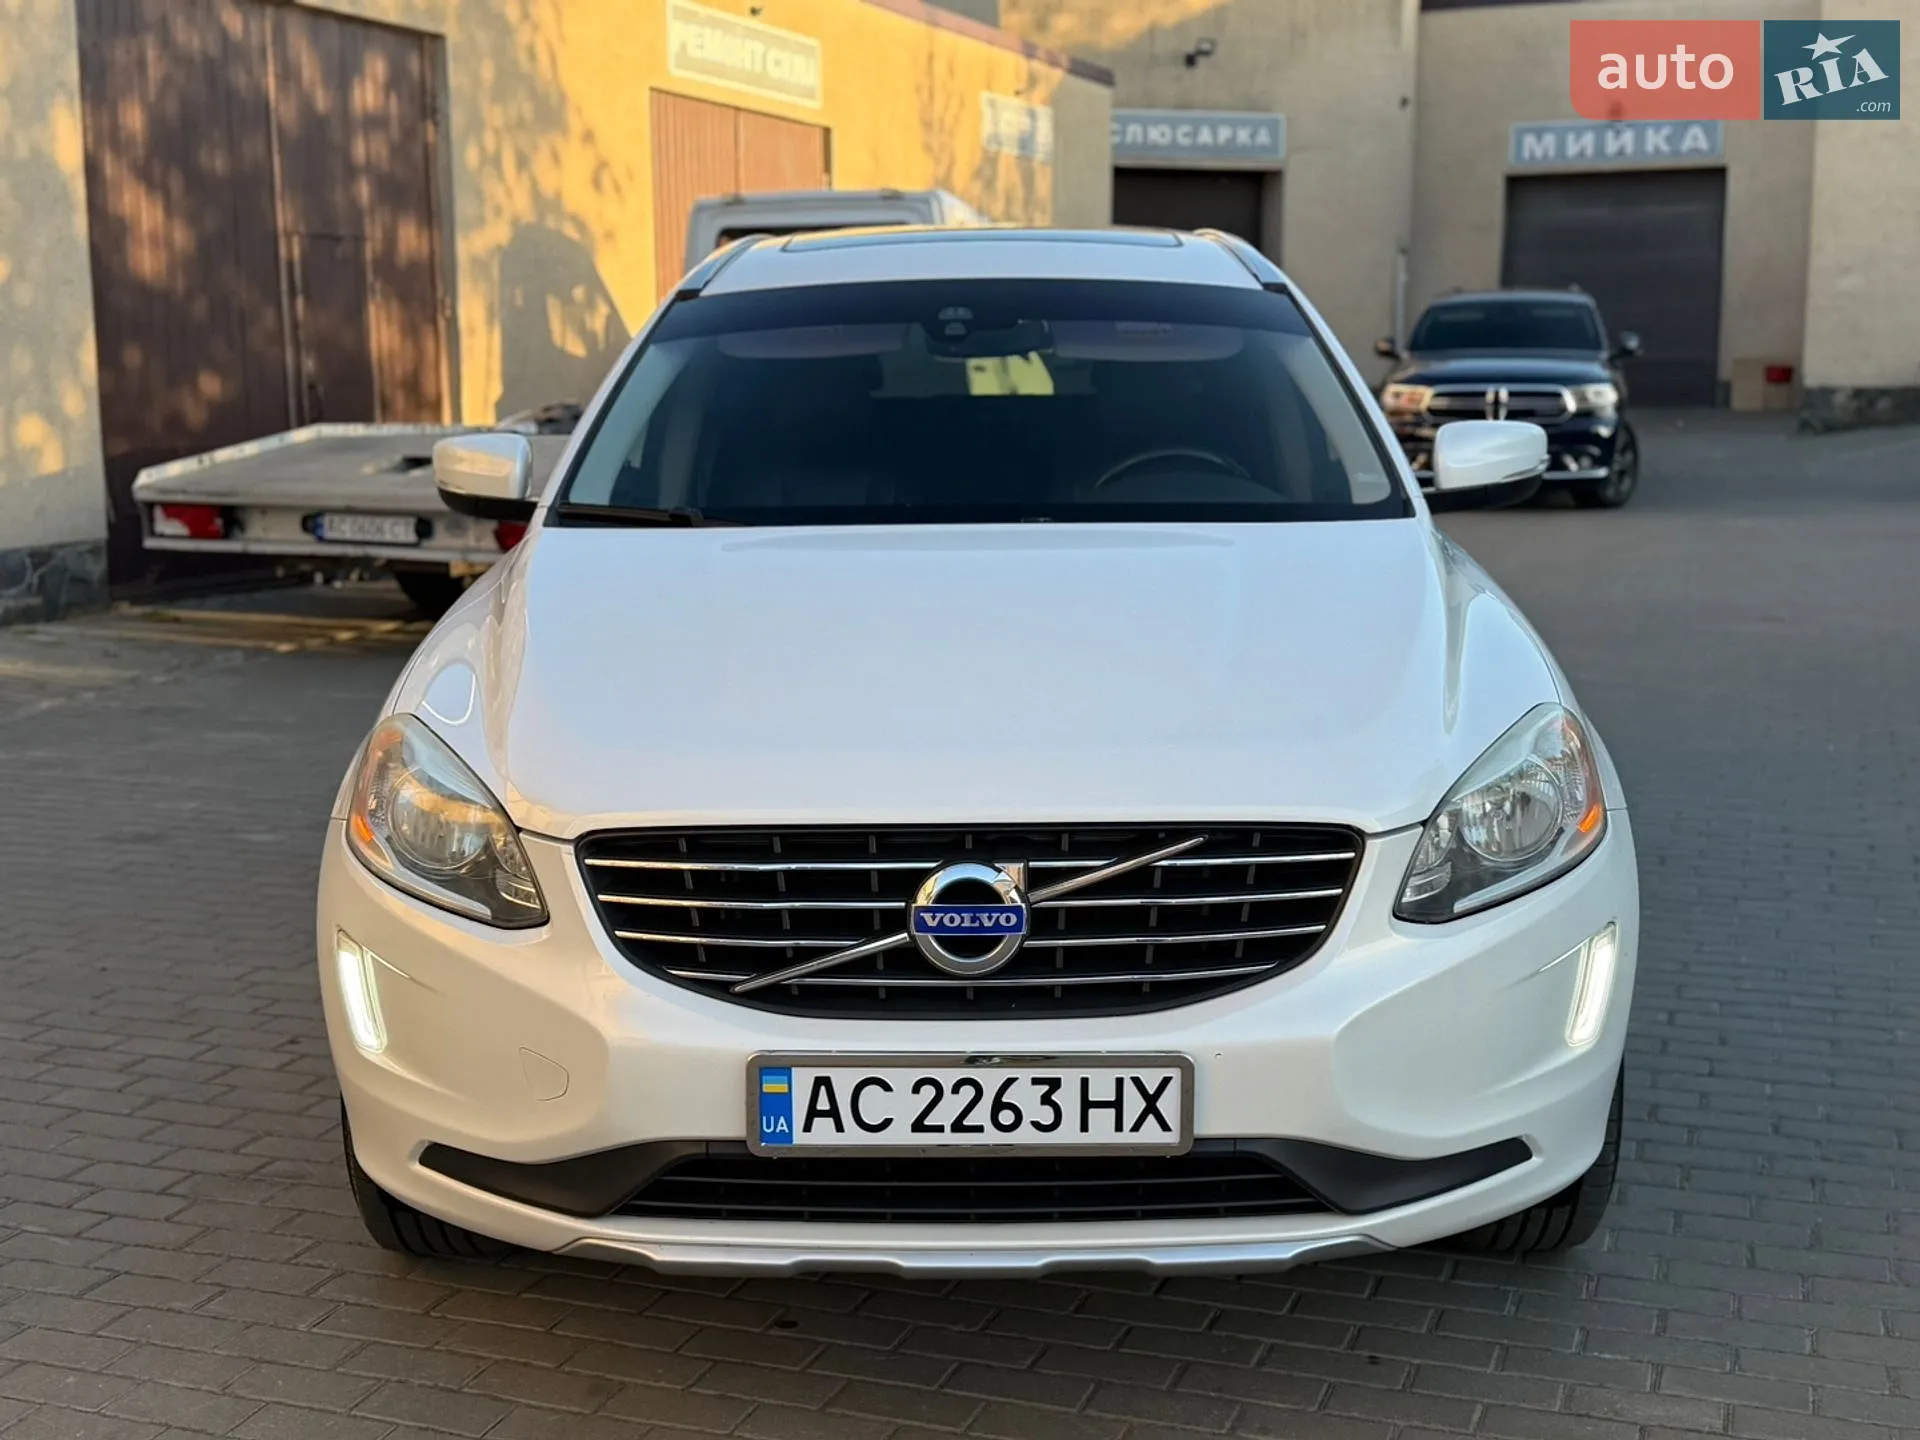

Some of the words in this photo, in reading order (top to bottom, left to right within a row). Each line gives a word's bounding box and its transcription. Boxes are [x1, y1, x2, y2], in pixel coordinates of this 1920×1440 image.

[1522, 122, 1710, 161] МИЙКА
[920, 912, 1018, 928] VOLVO
[802, 1075, 895, 1134] AC
[909, 1075, 1063, 1134] 2263
[1079, 1075, 1174, 1133] HX
[762, 1117, 790, 1134] UA
